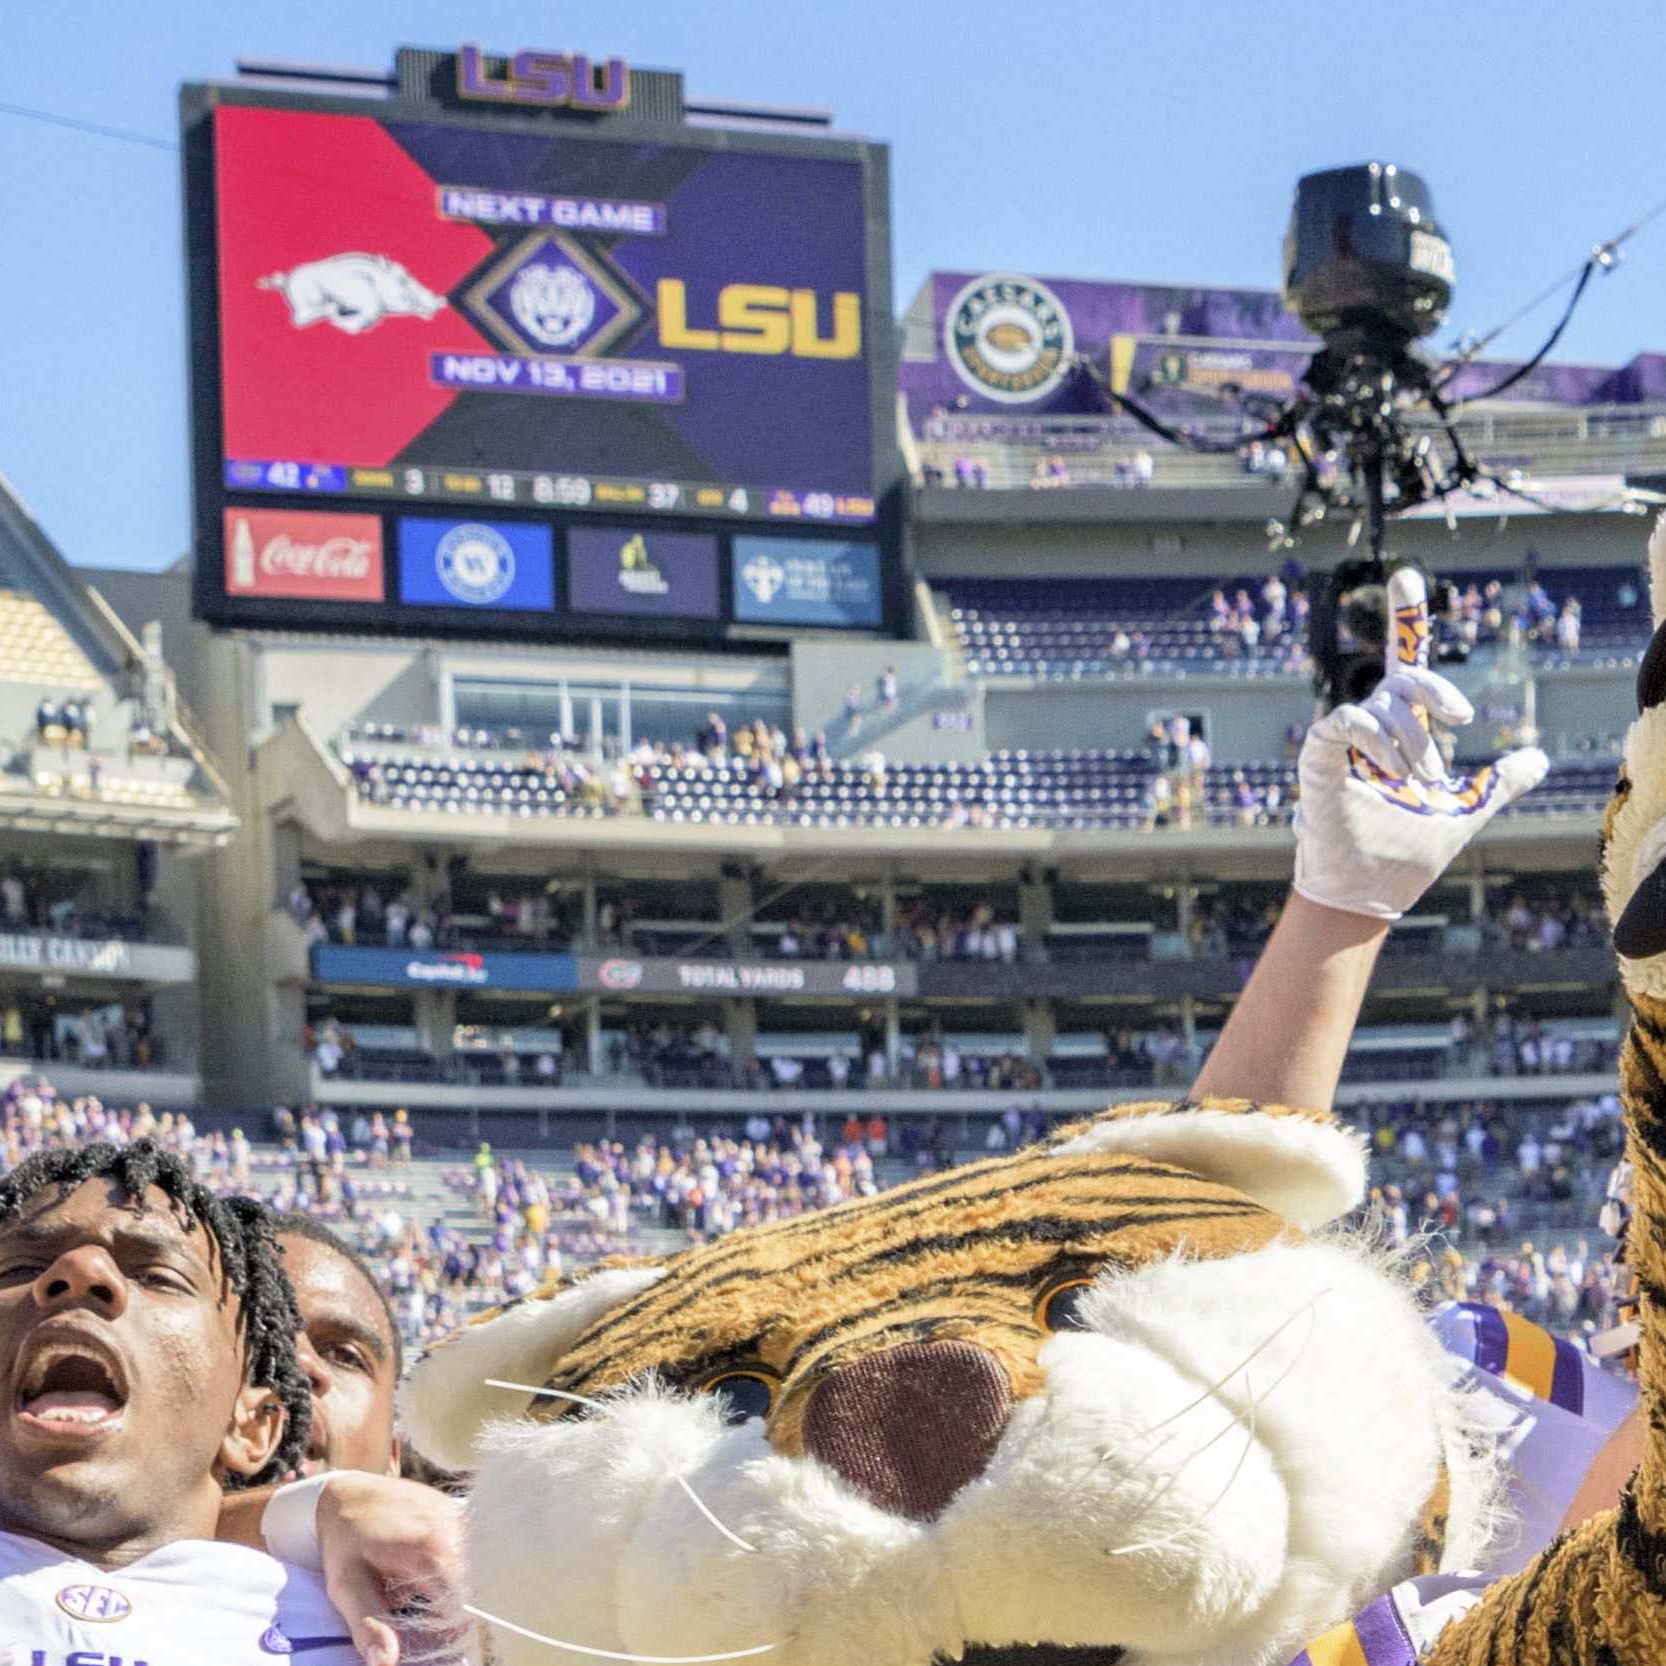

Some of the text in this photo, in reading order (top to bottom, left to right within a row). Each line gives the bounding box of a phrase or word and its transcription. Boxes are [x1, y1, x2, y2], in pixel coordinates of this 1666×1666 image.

[457, 43, 631, 113] LSU
[446, 192, 654, 231] NEXT GAME
[657, 277, 861, 360] LSU
[955, 281, 1061, 337] CAESARS
[444, 356, 668, 394] NOV 13, 2021
[404, 468, 425, 495] 3
[648, 482, 679, 509] 37
[729, 487, 749, 513] 4
[803, 491, 833, 518] 49
[677, 963, 739, 988] TOTAL
[741, 967, 805, 990] YARDS
